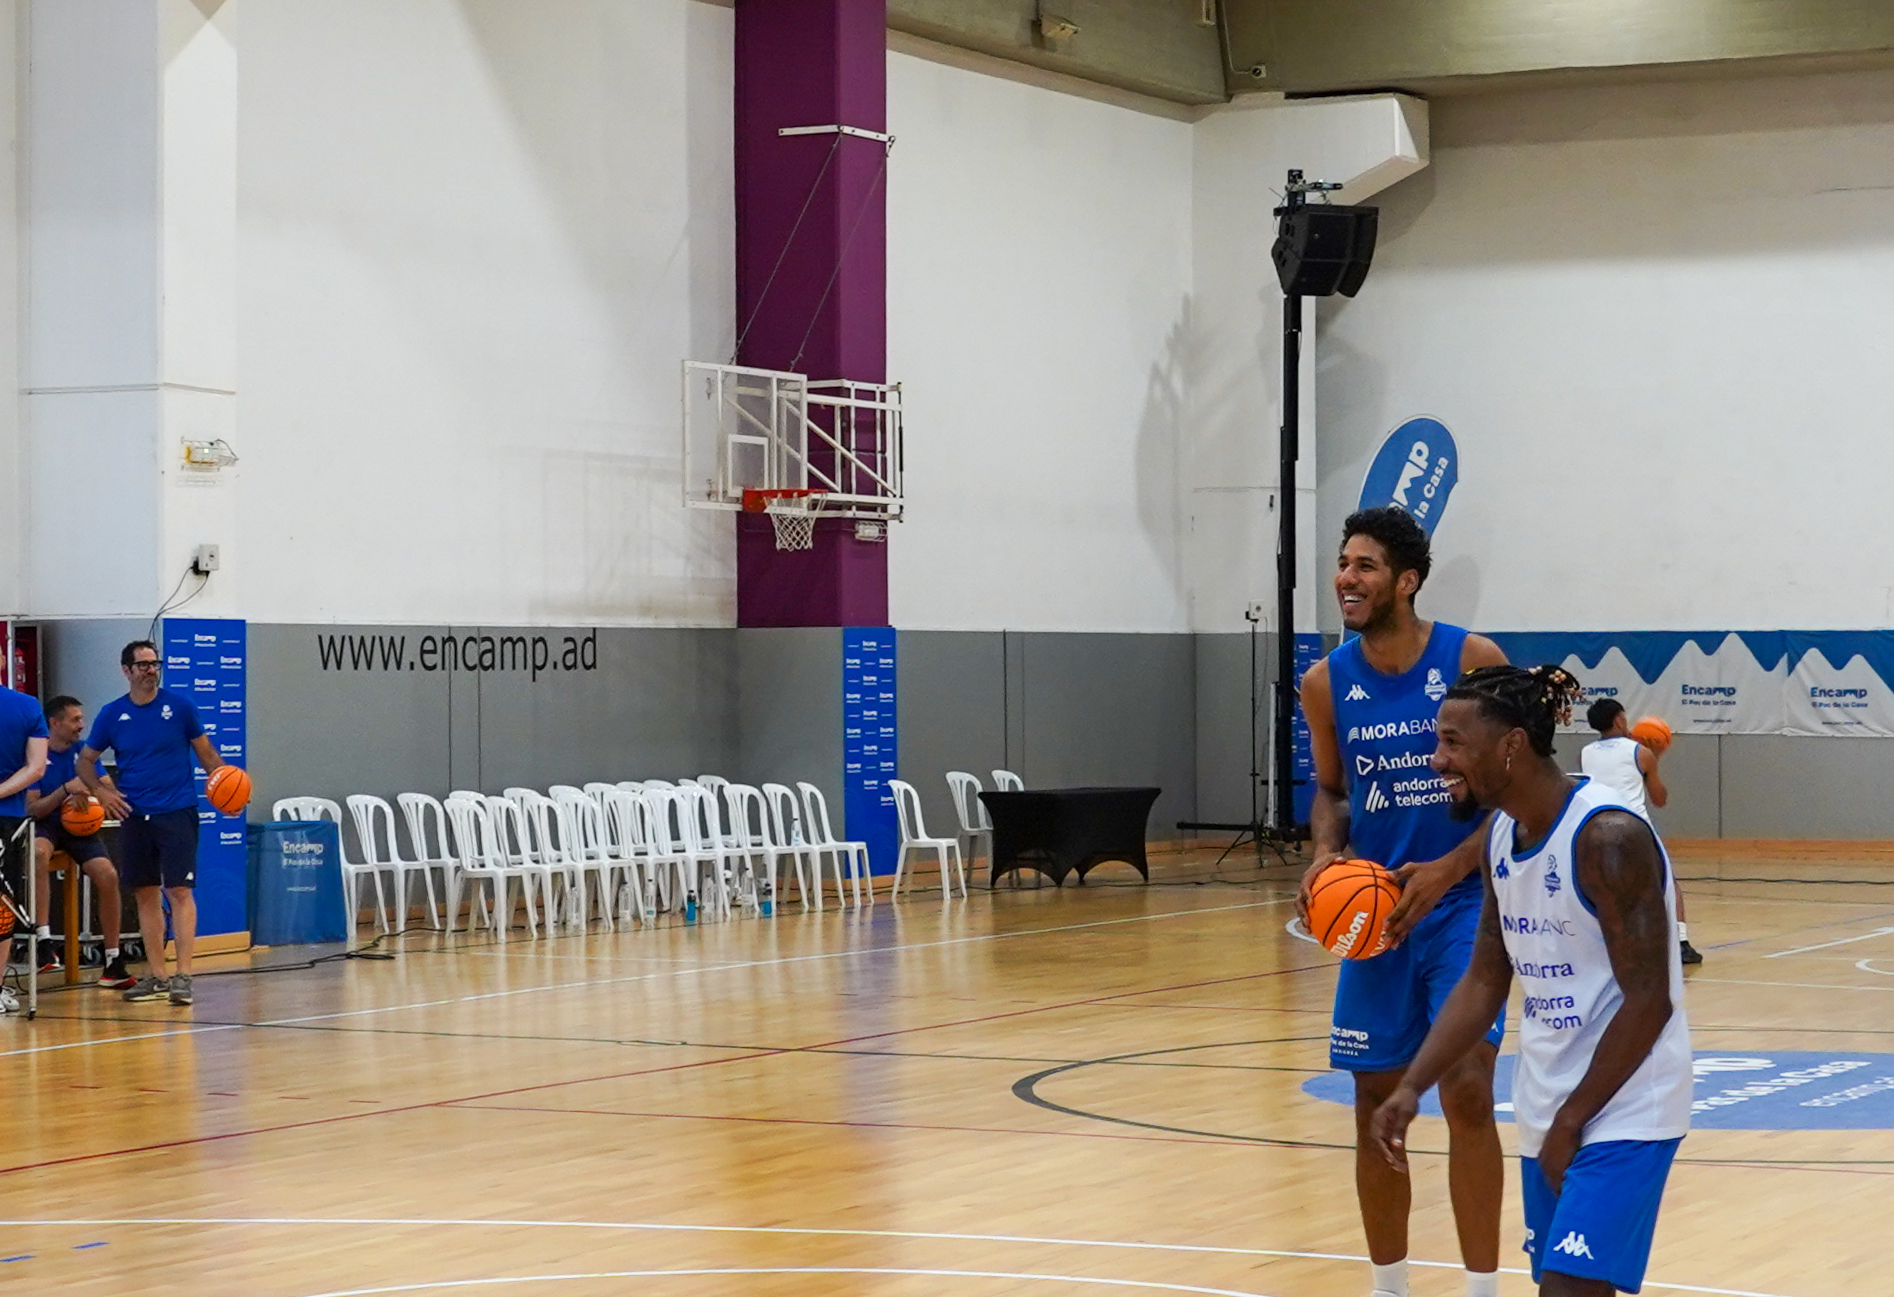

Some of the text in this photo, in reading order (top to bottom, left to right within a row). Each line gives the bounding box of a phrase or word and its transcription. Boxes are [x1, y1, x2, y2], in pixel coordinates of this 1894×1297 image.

[1423, 457, 1449, 498] Casa
[318, 627, 598, 682] www.encamp.ad
[1581, 687, 1618, 698] camp
[1682, 684, 1736, 697] Encamp
[1810, 687, 1868, 698] Encamp
[1361, 718, 1439, 741] MORABAN
[1377, 751, 1435, 772] Andorr
[1395, 792, 1454, 808] telecom
[283, 841, 324, 855] Encamp
[1330, 910, 1369, 957] Wilson
